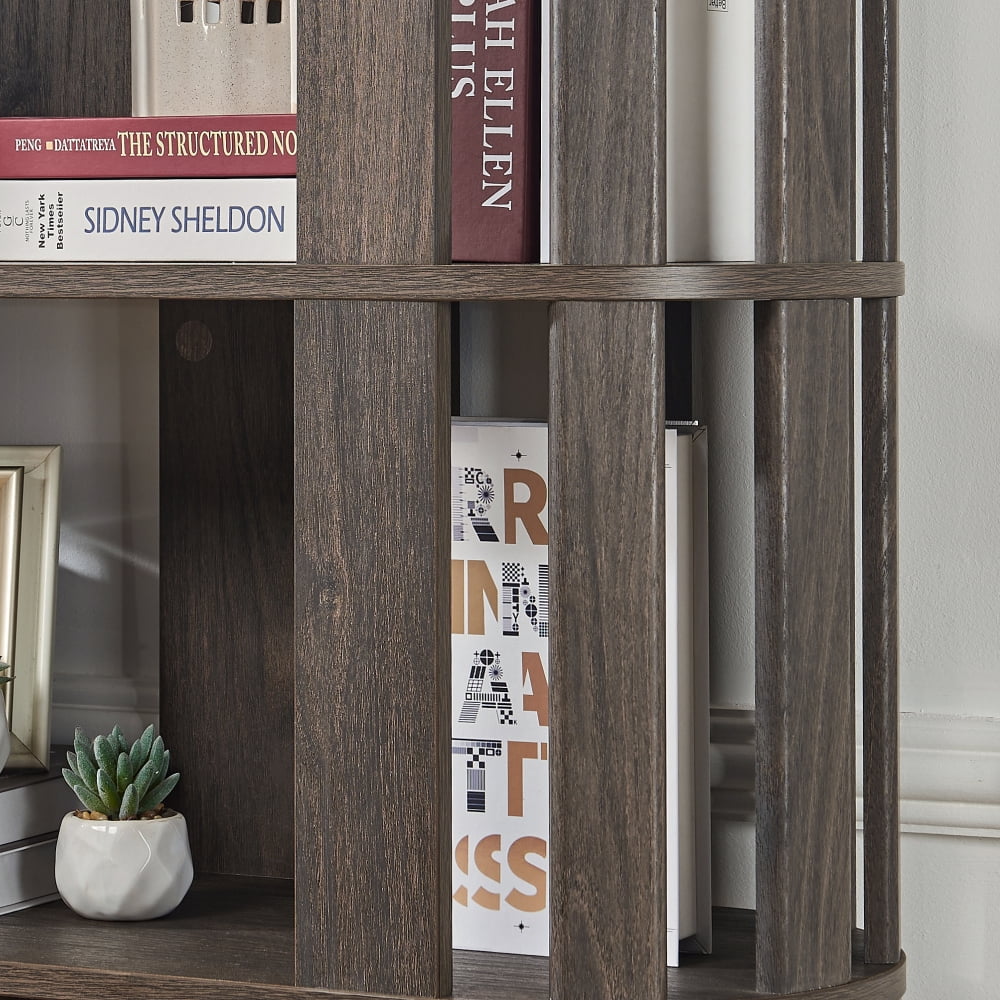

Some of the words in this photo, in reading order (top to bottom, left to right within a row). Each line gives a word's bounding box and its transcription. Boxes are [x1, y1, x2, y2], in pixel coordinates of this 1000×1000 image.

[15, 138, 42, 152] PENG
[54, 137, 116, 152] DATTATREYA
[117, 130, 152, 157] THE
[156, 130, 269, 157] STRUCTURED
[482, 67, 515, 212] ELLEN
[84, 206, 166, 234] SIDNEY
[171, 205, 285, 234] SHELDON
[38, 223, 46, 248] New
